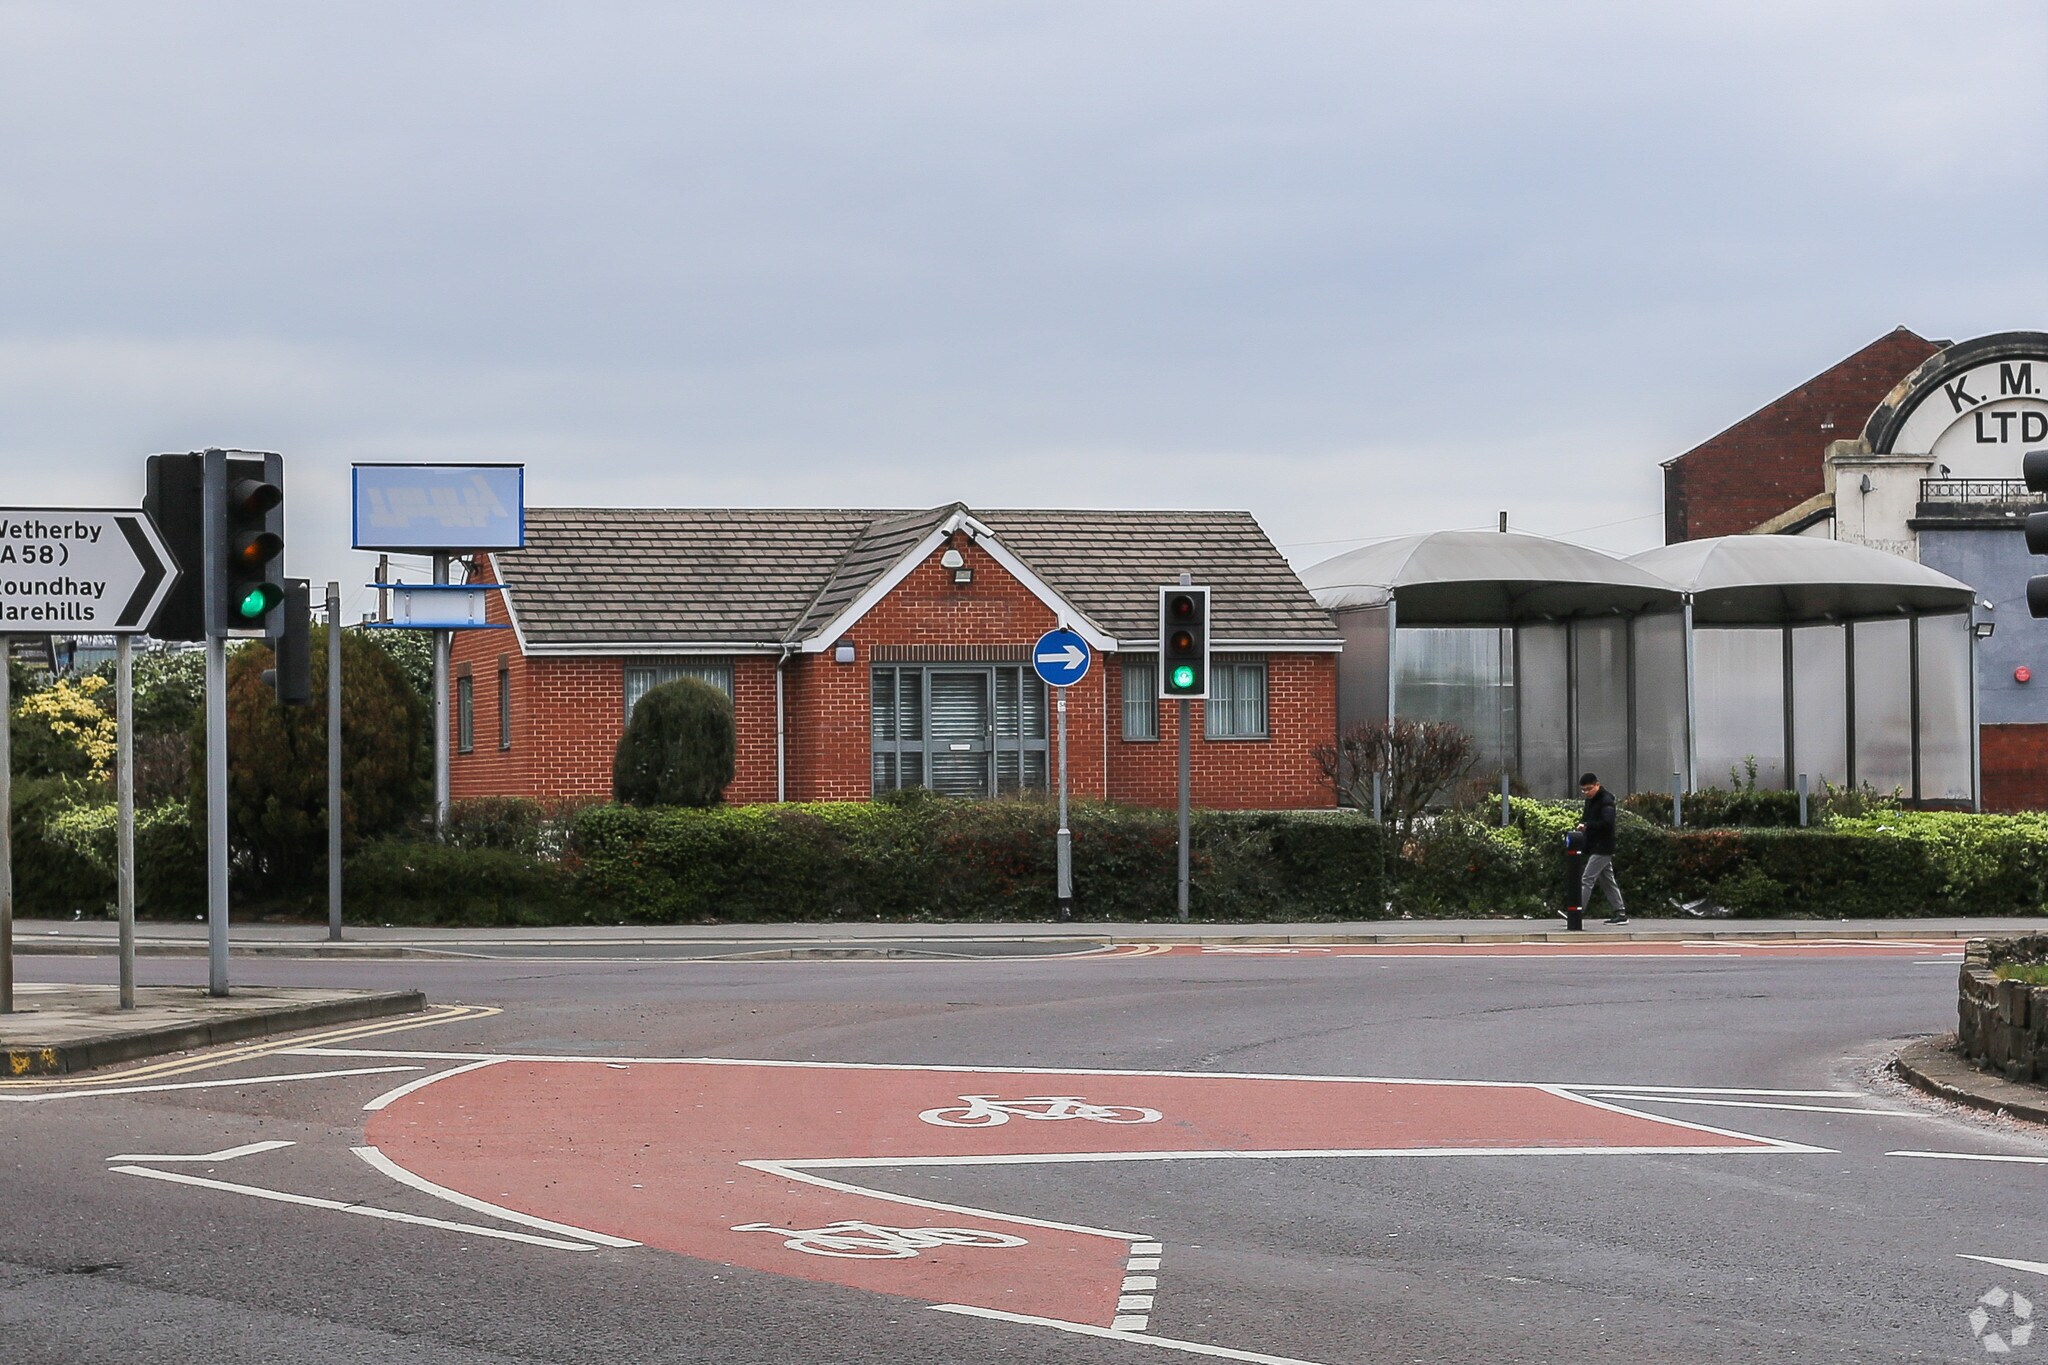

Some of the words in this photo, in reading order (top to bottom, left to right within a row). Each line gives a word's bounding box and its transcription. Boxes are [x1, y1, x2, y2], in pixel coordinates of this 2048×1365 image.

[1944, 375, 1987, 413] K.
[2000, 363, 2040, 394] M.
[1975, 411, 2048, 443] LTD
[0, 577, 106, 599] oundhay
[0, 602, 95, 620] arehills
